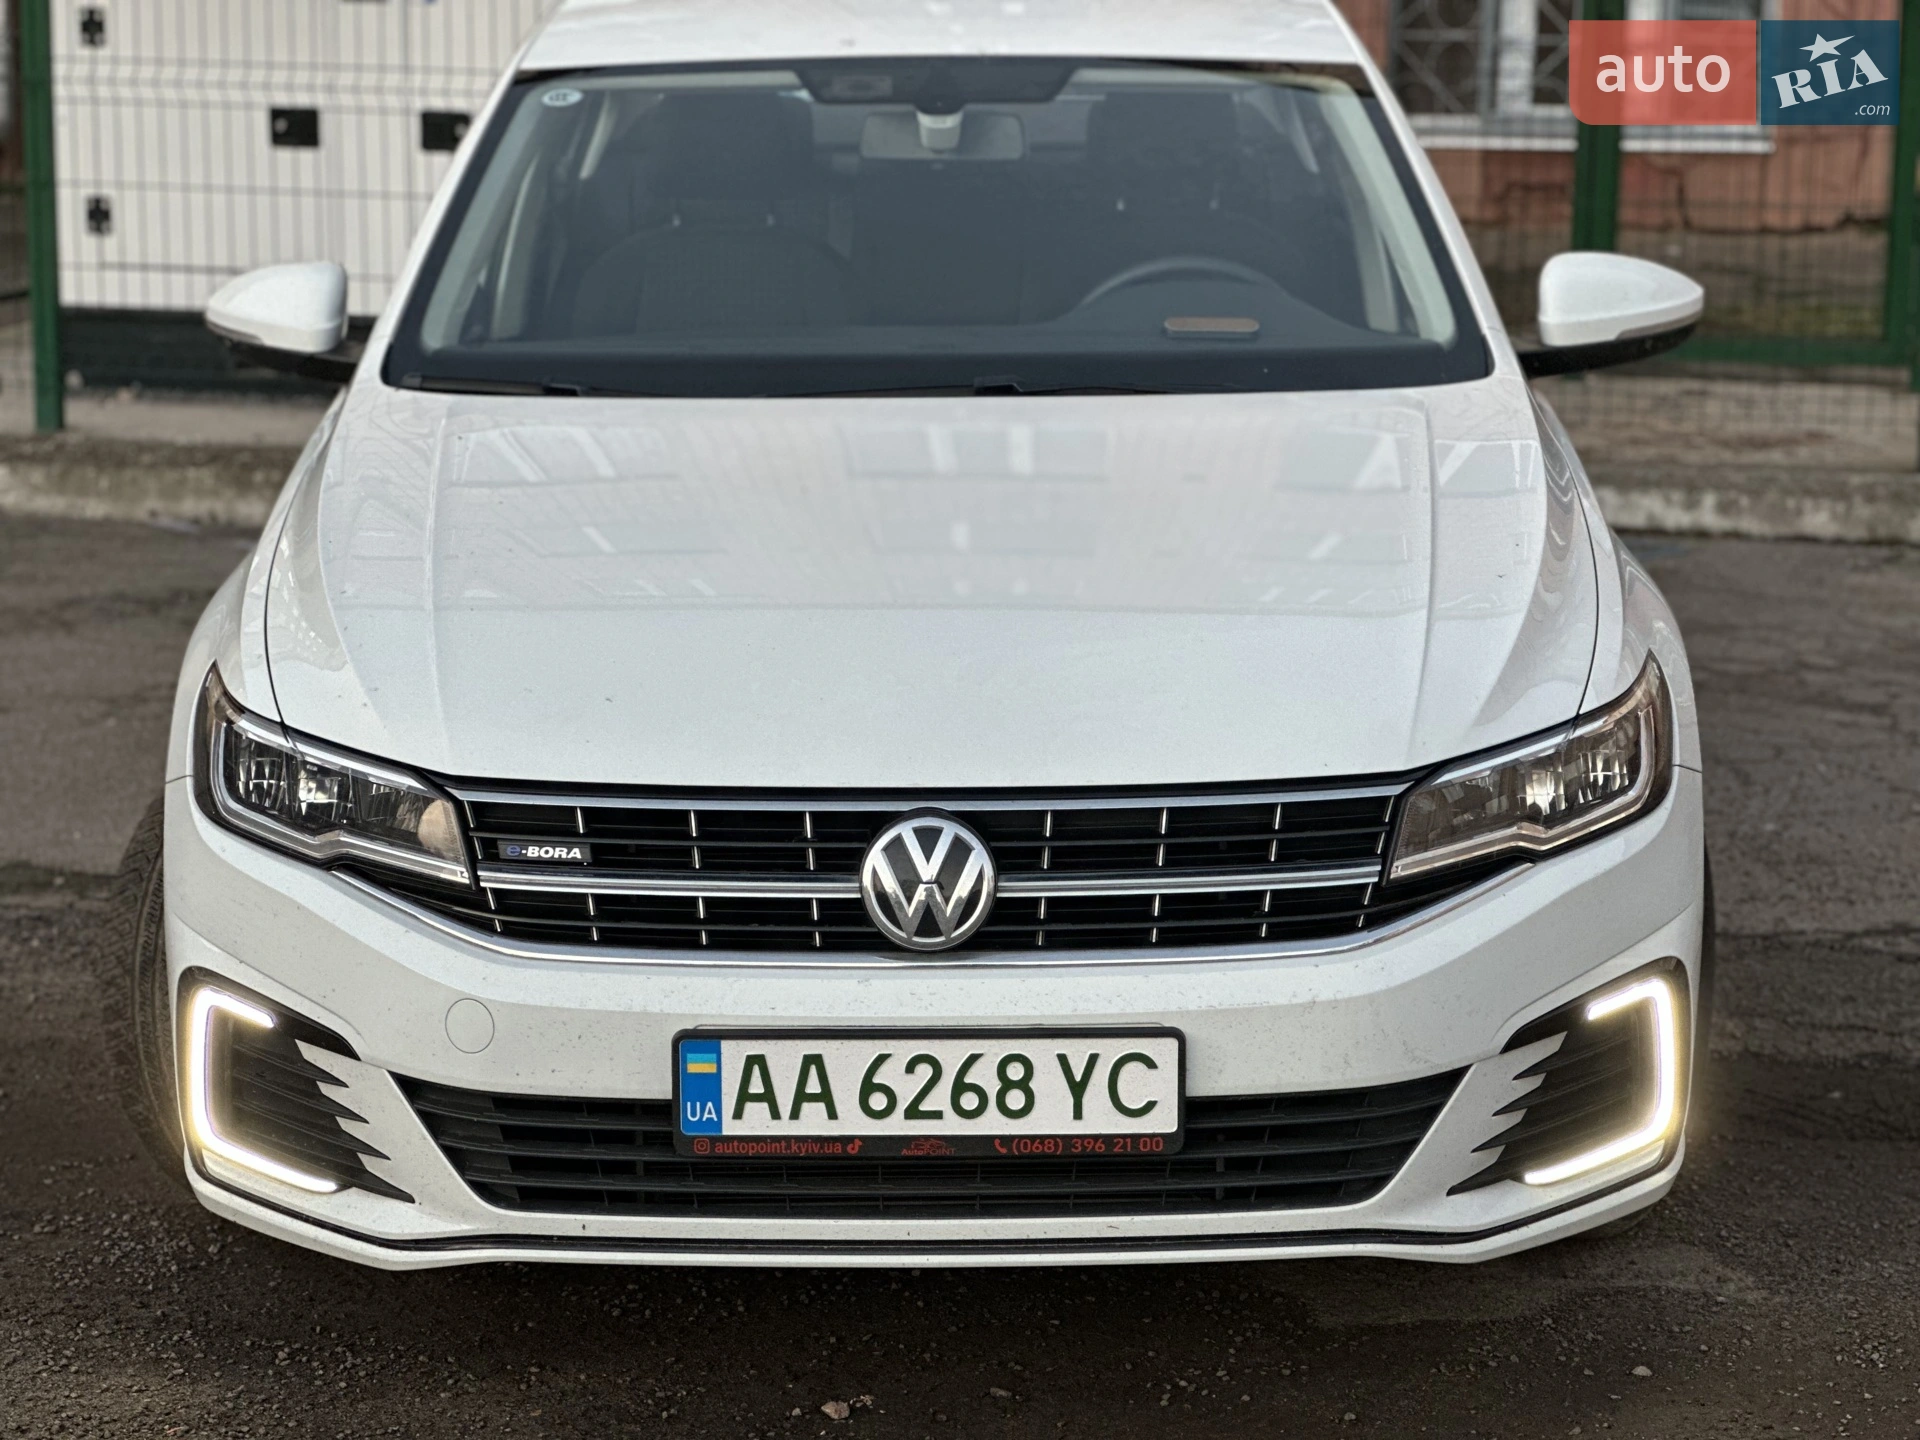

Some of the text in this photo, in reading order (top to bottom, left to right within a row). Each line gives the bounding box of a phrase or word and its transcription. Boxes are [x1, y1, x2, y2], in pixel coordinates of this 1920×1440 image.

[506, 845, 582, 859] e-BORA
[872, 815, 986, 945] VW
[732, 1052, 1159, 1121] AA 6268 YC
[686, 1101, 718, 1122] UA
[714, 1139, 842, 1156] autopoint.kyiv.ua
[1012, 1137, 1164, 1155] (068) 396 21 00
